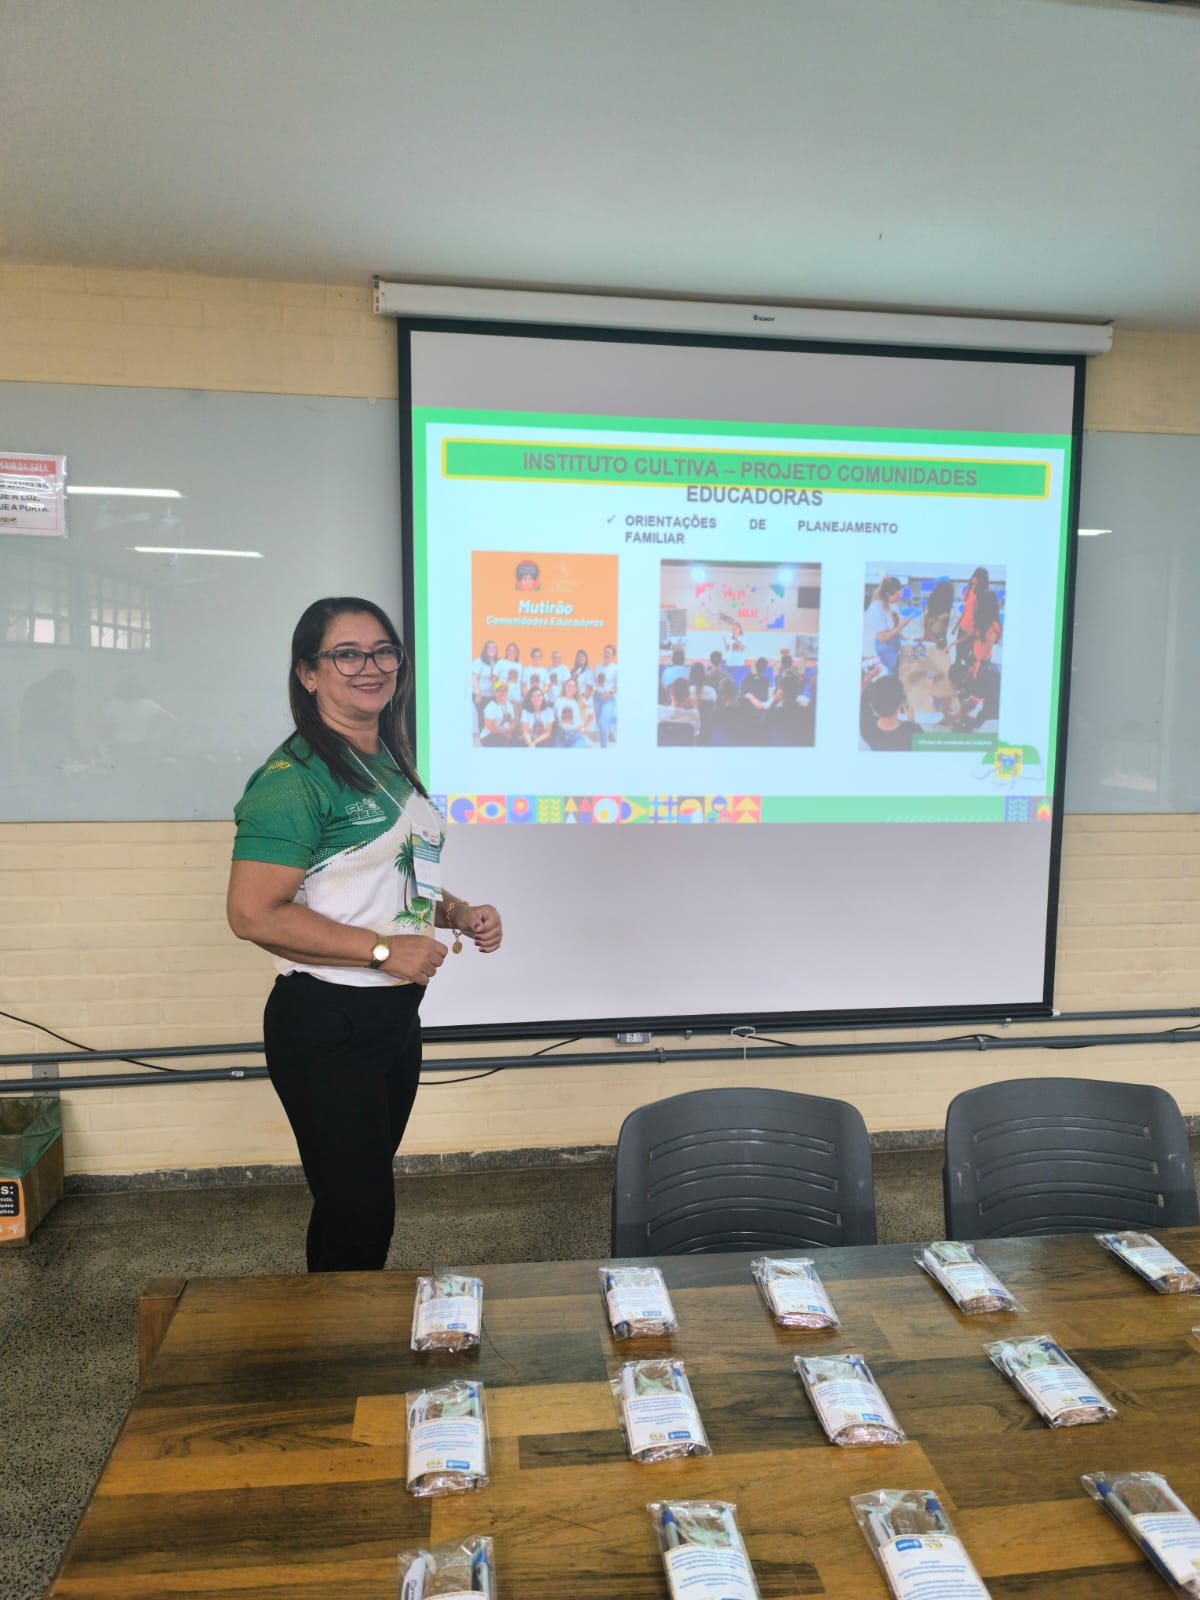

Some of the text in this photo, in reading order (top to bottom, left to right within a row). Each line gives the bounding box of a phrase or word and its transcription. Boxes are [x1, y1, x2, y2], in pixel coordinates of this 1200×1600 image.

[523, 452, 628, 475] INSTITUTO
[634, 457, 719, 478] CULTIVA
[740, 461, 832, 482] PROJETO
[837, 465, 977, 487] COMUNIDADES
[686, 486, 823, 506] EDUCADORAS
[625, 514, 899, 534] ORIENTAÇÕES DE PLANEJAMENTO
[625, 531, 685, 545] FAMILIAR
[518, 600, 574, 616] Mutirão
[486, 615, 605, 628] Comunidades Educadoras
